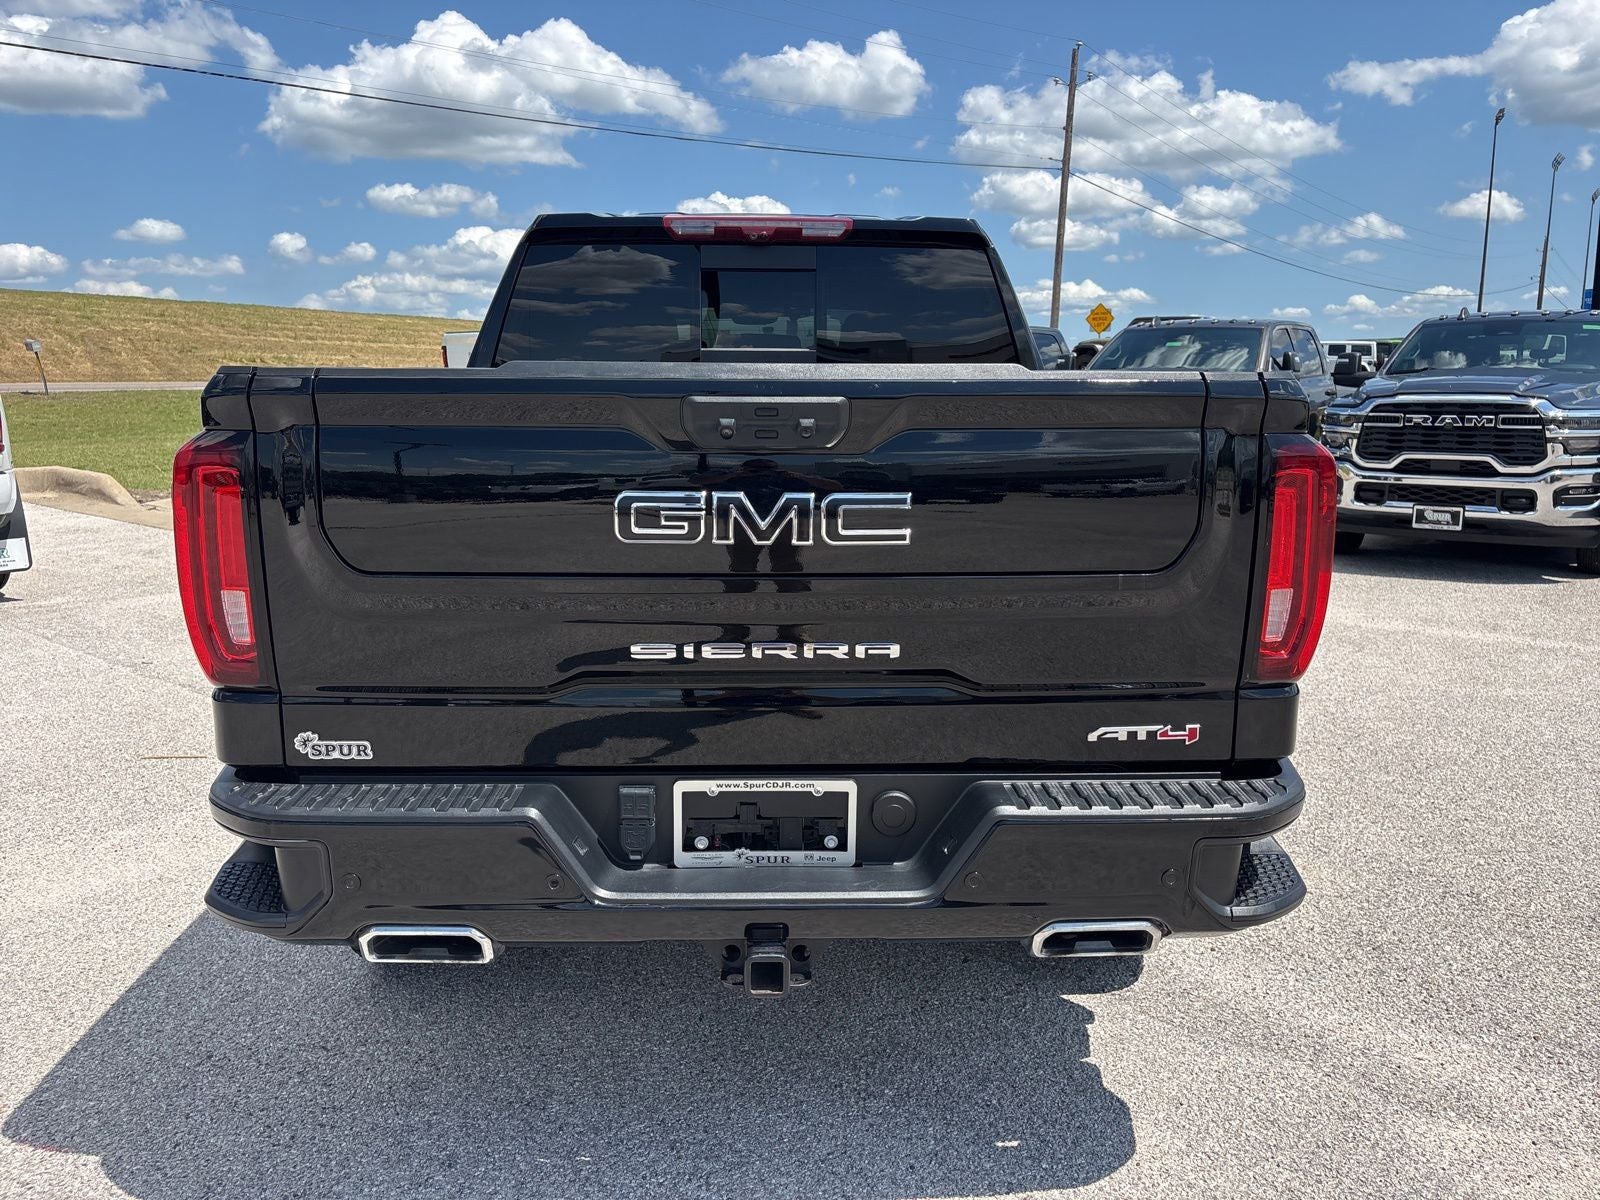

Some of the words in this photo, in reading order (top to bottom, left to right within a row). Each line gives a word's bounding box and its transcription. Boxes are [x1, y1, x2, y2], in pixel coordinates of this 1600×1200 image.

[1404, 414, 1496, 427] RAM
[614, 490, 912, 546] GMC
[630, 643, 900, 660] SIERRA
[1087, 724, 1201, 745] AT4
[311, 744, 369, 757] SPUR
[716, 781, 815, 790] www.SpurCDJR.com
[745, 855, 791, 864] SPUR
[816, 855, 837, 863] Jeep
